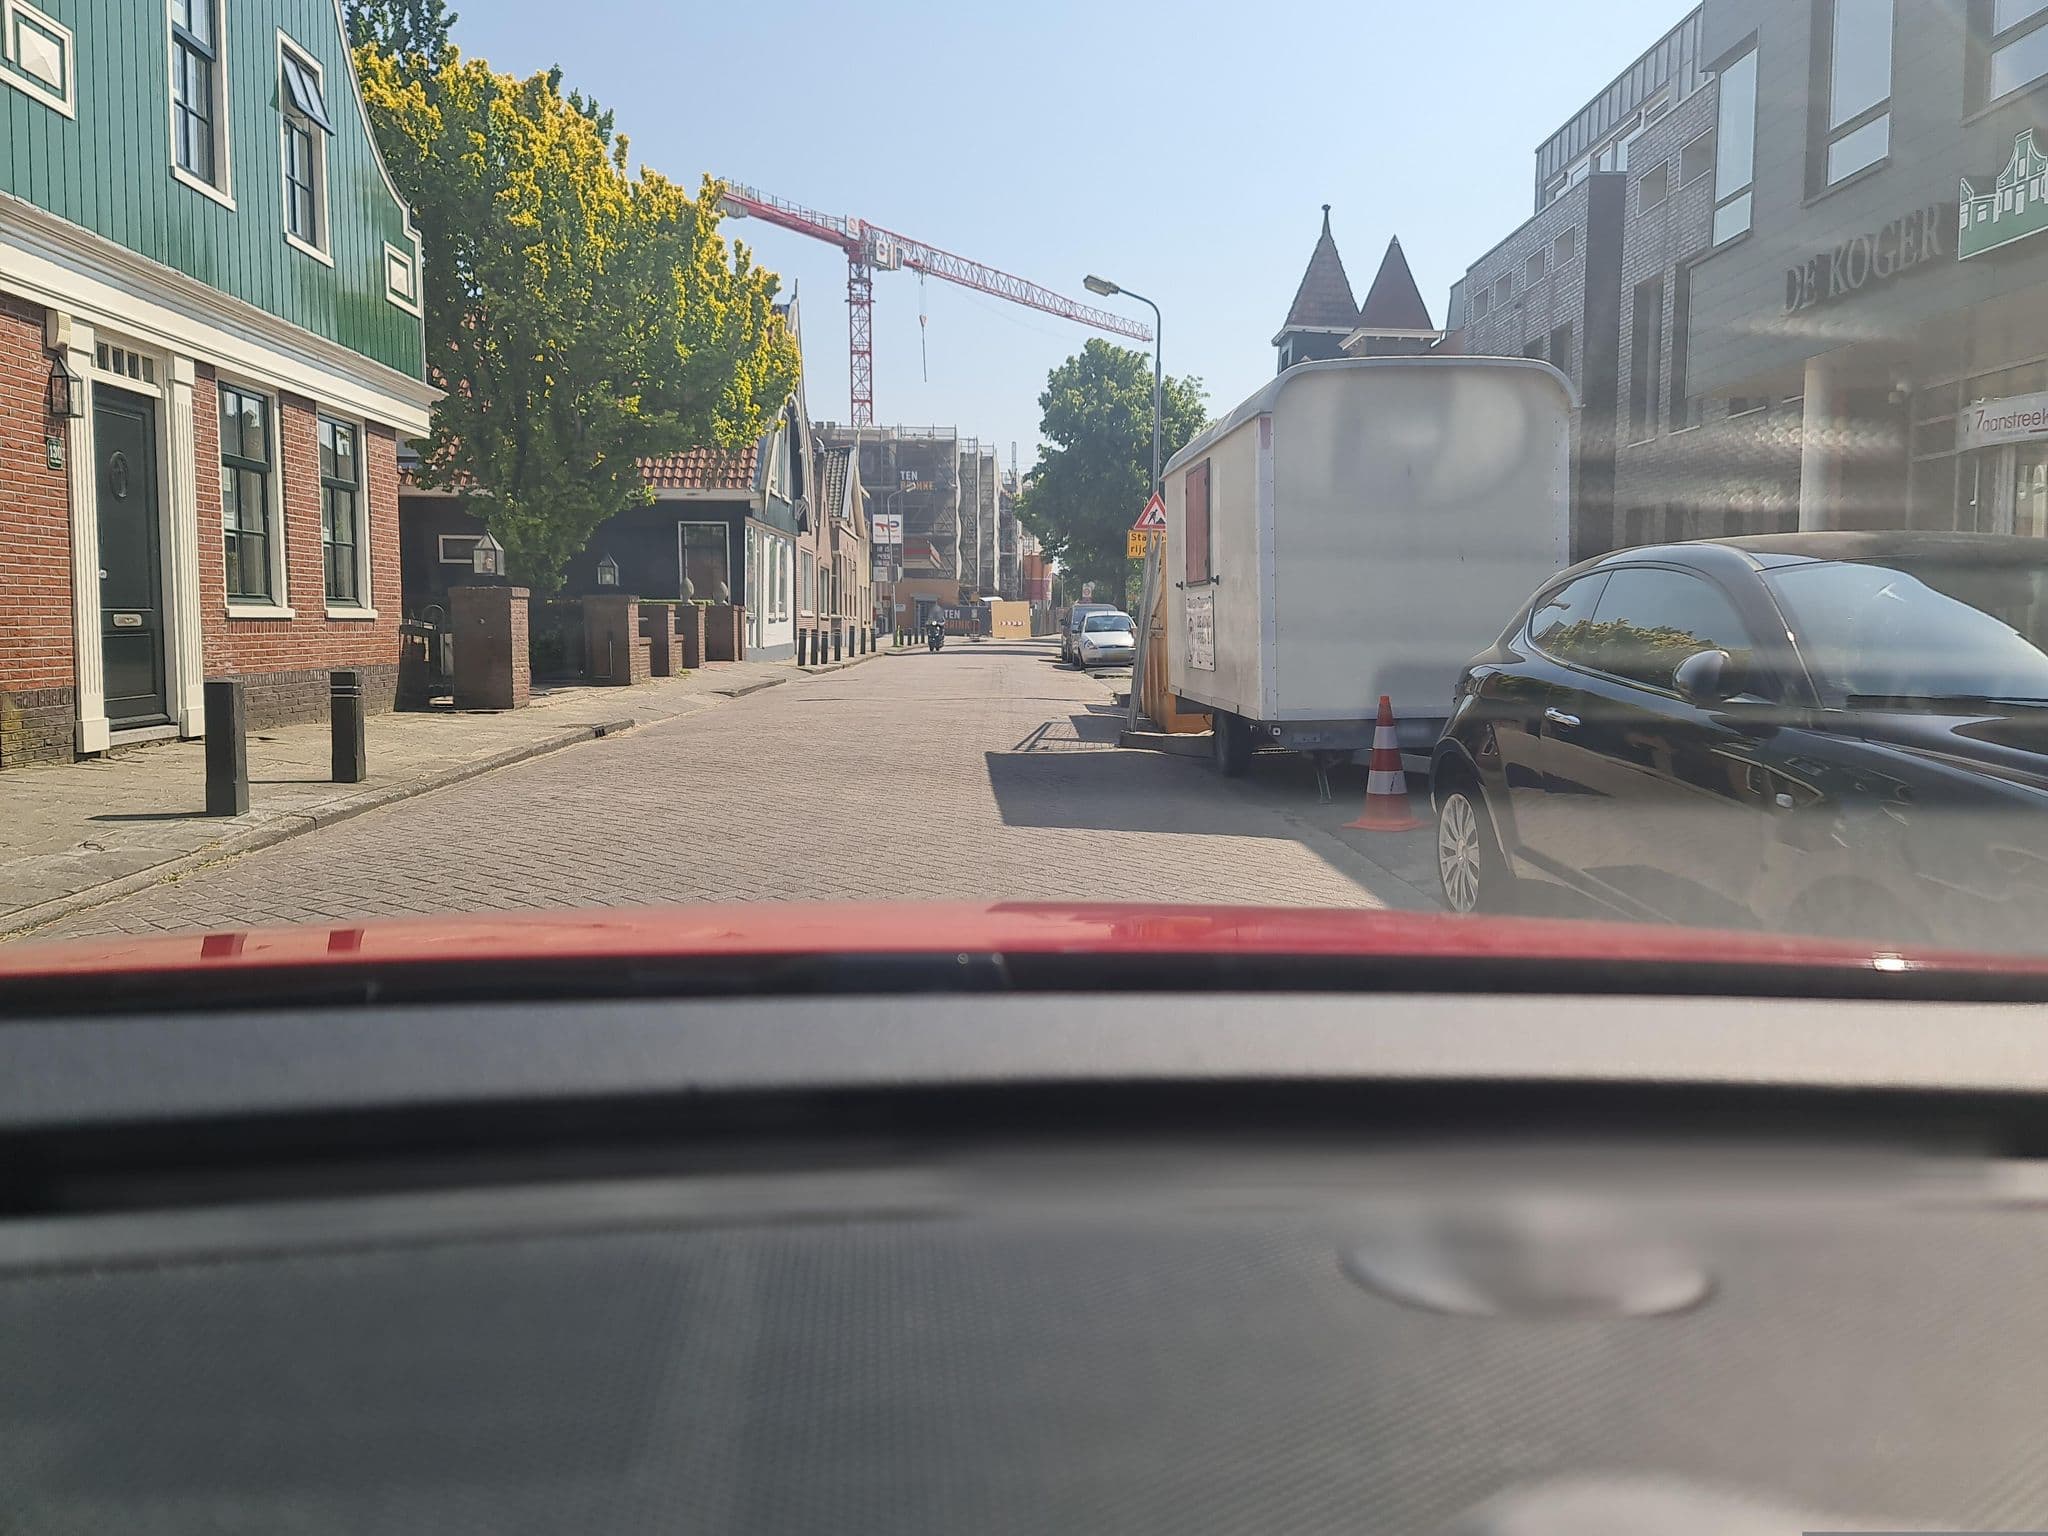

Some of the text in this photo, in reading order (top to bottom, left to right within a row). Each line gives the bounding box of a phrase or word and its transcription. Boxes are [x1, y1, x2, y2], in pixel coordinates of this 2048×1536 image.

[1783, 204, 1944, 315] DE KOGER
[900, 470, 918, 480] TEN
[944, 609, 960, 619] TEN
